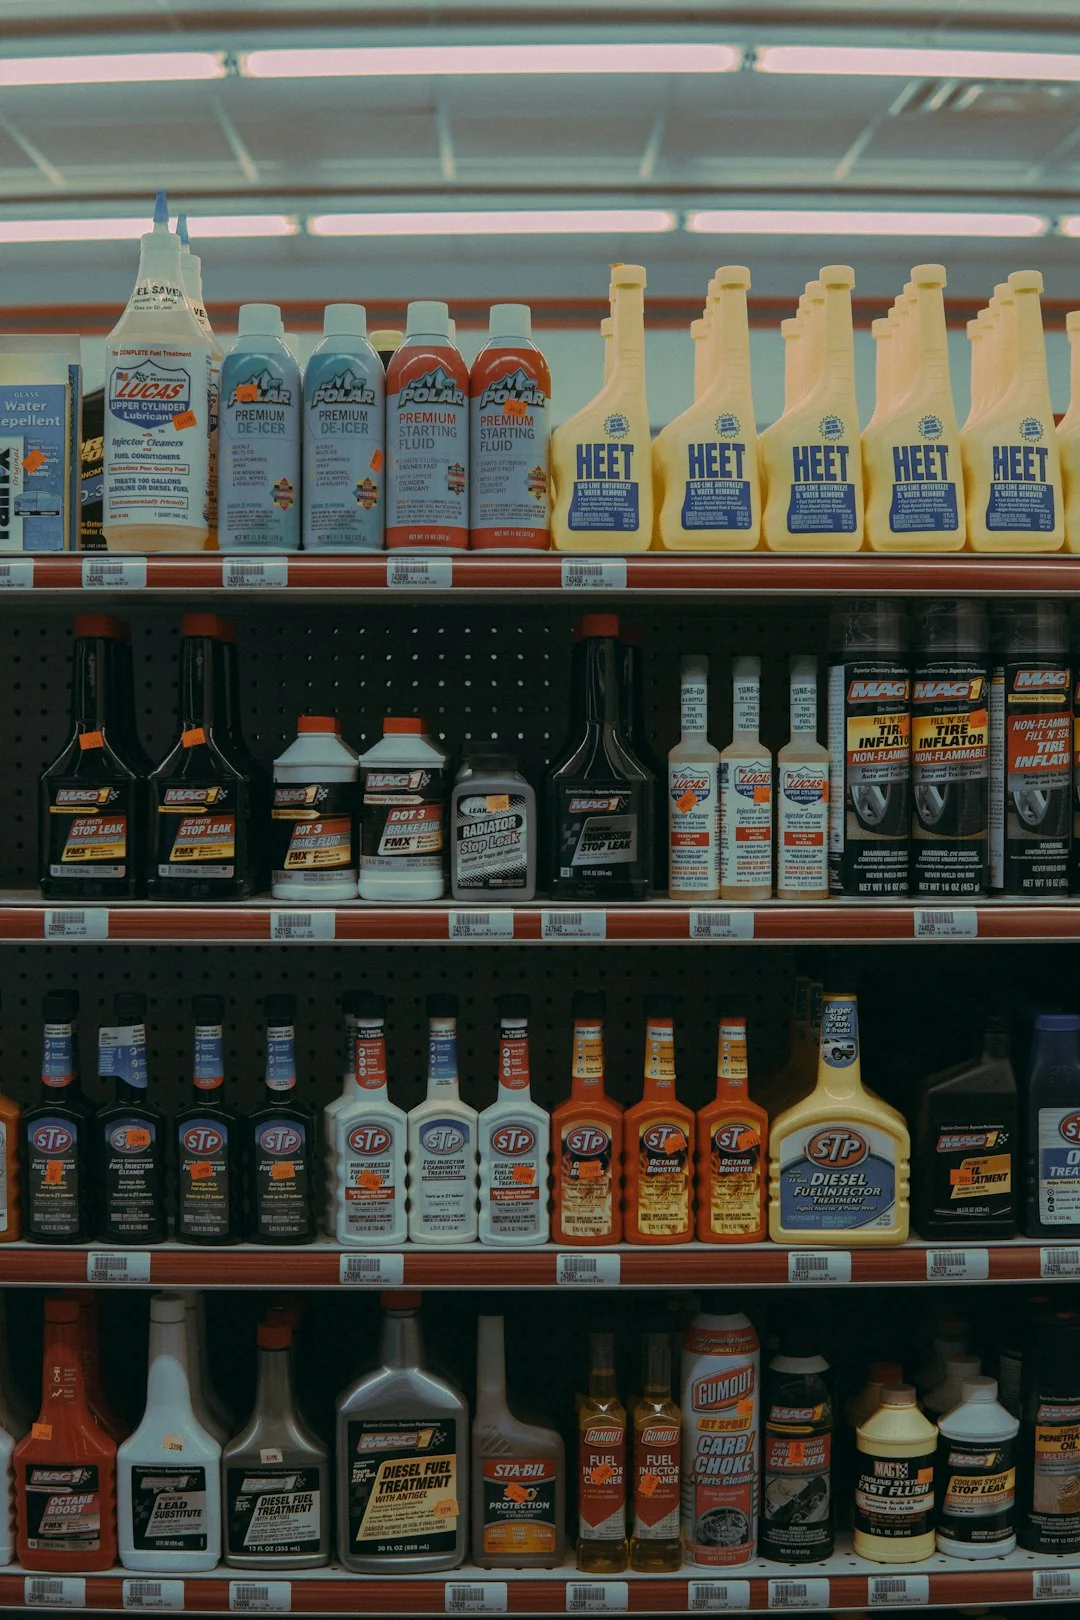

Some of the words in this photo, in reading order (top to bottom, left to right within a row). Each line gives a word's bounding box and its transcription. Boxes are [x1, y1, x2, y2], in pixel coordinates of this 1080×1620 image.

[116, 383, 184, 399] LUCAS
[311, 390, 375, 409] POLAR
[397, 387, 464, 409] POLAR
[480, 388, 545, 410] POLAR
[4, 401, 47, 412] Water
[111, 401, 139, 411] UPPER
[142, 402, 185, 412] CYLINDER
[236, 411, 284, 421] PREMIUM
[319, 411, 368, 421] PREMIUM
[399, 413, 456, 424] PREMIUM
[480, 416, 534, 426] PREMIUM
[238, 422, 285, 434] DE-ICER
[321, 422, 368, 434] DE-ICER
[399, 426, 457, 438] STARTING
[480, 428, 534, 439] STARTING
[112, 438, 144, 447] Injector
[146, 438, 183, 447] Cleaners
[399, 438, 434, 450] FLUID
[480, 441, 512, 452] FLUID
[576, 444, 634, 480] HEET
[688, 443, 745, 479] HEET
[792, 445, 849, 482] HEET
[892, 445, 949, 481] HEET
[992, 446, 1049, 482] HEET
[913, 677, 984, 703] MAG1
[873, 717, 888, 725] FILL
[931, 717, 945, 725] FILL
[936, 725, 968, 736] TIRE
[1025, 731, 1043, 740] FILL
[919, 734, 984, 749] INFLATOR
[1037, 741, 1065, 753] TIRE
[914, 748, 987, 763] NON-FLAMMABLE
[673, 780, 707, 789] LUCAS
[741, 775, 770, 783] LUCAS
[787, 779, 822, 789] LUCAS
[57, 787, 113, 805] MAG1
[571, 796, 620, 812] MAG1
[391, 810, 415, 821] DOT
[417, 810, 426, 819] 3
[72, 825, 98, 836] STOP
[99, 824, 123, 834] LEAK
[180, 825, 206, 836] STOP
[207, 824, 232, 834] LEAK
[295, 824, 312, 834] DOT
[314, 824, 322, 833] 3
[387, 824, 416, 834] BRAKE
[463, 817, 517, 838] RADIATOR
[292, 838, 315, 848] BRAKE
[317, 836, 340, 845] FLUID
[384, 838, 410, 847] FMX
[460, 838, 487, 855] Stop
[489, 832, 521, 849] Leak
[580, 843, 605, 852] STOP
[608, 840, 631, 850] LEAK
[66, 848, 86, 856] FMX
[174, 847, 194, 856] FMX
[289, 852, 307, 861] FMX
[825, 1006, 853, 1016] Larger
[829, 1014, 847, 1022] Size
[37, 1129, 68, 1149] STP
[187, 1130, 218, 1151] STP
[266, 1130, 297, 1151] STP
[355, 1130, 386, 1150] STP
[427, 1129, 460, 1150] STP
[498, 1130, 530, 1150] STP
[571, 1131, 603, 1151] STP
[940, 1130, 999, 1149] MAG1
[814, 1134, 861, 1161] STP
[810, 1173, 867, 1187] DIESEL
[812, 1197, 865, 1205] TREATMENT
[698, 1368, 752, 1406] GUMOUT
[700, 1419, 717, 1429] JET
[718, 1417, 749, 1429] SPRAY
[588, 1431, 621, 1442] GUMOUT
[645, 1431, 678, 1441] GUMOUT
[1060, 1442, 1078, 1451] OIL
[590, 1455, 617, 1466] FUEL
[646, 1455, 674, 1465] FUEL
[695, 1455, 752, 1475] CHOKE
[382, 1463, 421, 1479] DIESEL
[425, 1460, 451, 1473] FUEL
[494, 1464, 545, 1476] STA-BIL
[379, 1475, 452, 1494] TREATMENT
[697, 1476, 716, 1486] Parts
[717, 1474, 754, 1485] Cleaner
[953, 1478, 983, 1486] COOLING
[858, 1482, 887, 1495] FAST
[889, 1485, 930, 1496] FLUSH
[951, 1485, 980, 1494] STOP
[981, 1482, 1006, 1492] LEAK
[50, 1495, 93, 1505] OCTANE
[260, 1495, 290, 1506] DIESEL
[292, 1494, 313, 1504] FUEL
[375, 1494, 396, 1503] WITH
[397, 1492, 427, 1501] ANTIGEL
[48, 1505, 84, 1515] BOOST
[157, 1502, 187, 1510] LEAD
[257, 1504, 313, 1516] TREATMENT
[489, 1502, 550, 1510] PROTECTION
[154, 1510, 202, 1519] SUBSTITUTE
